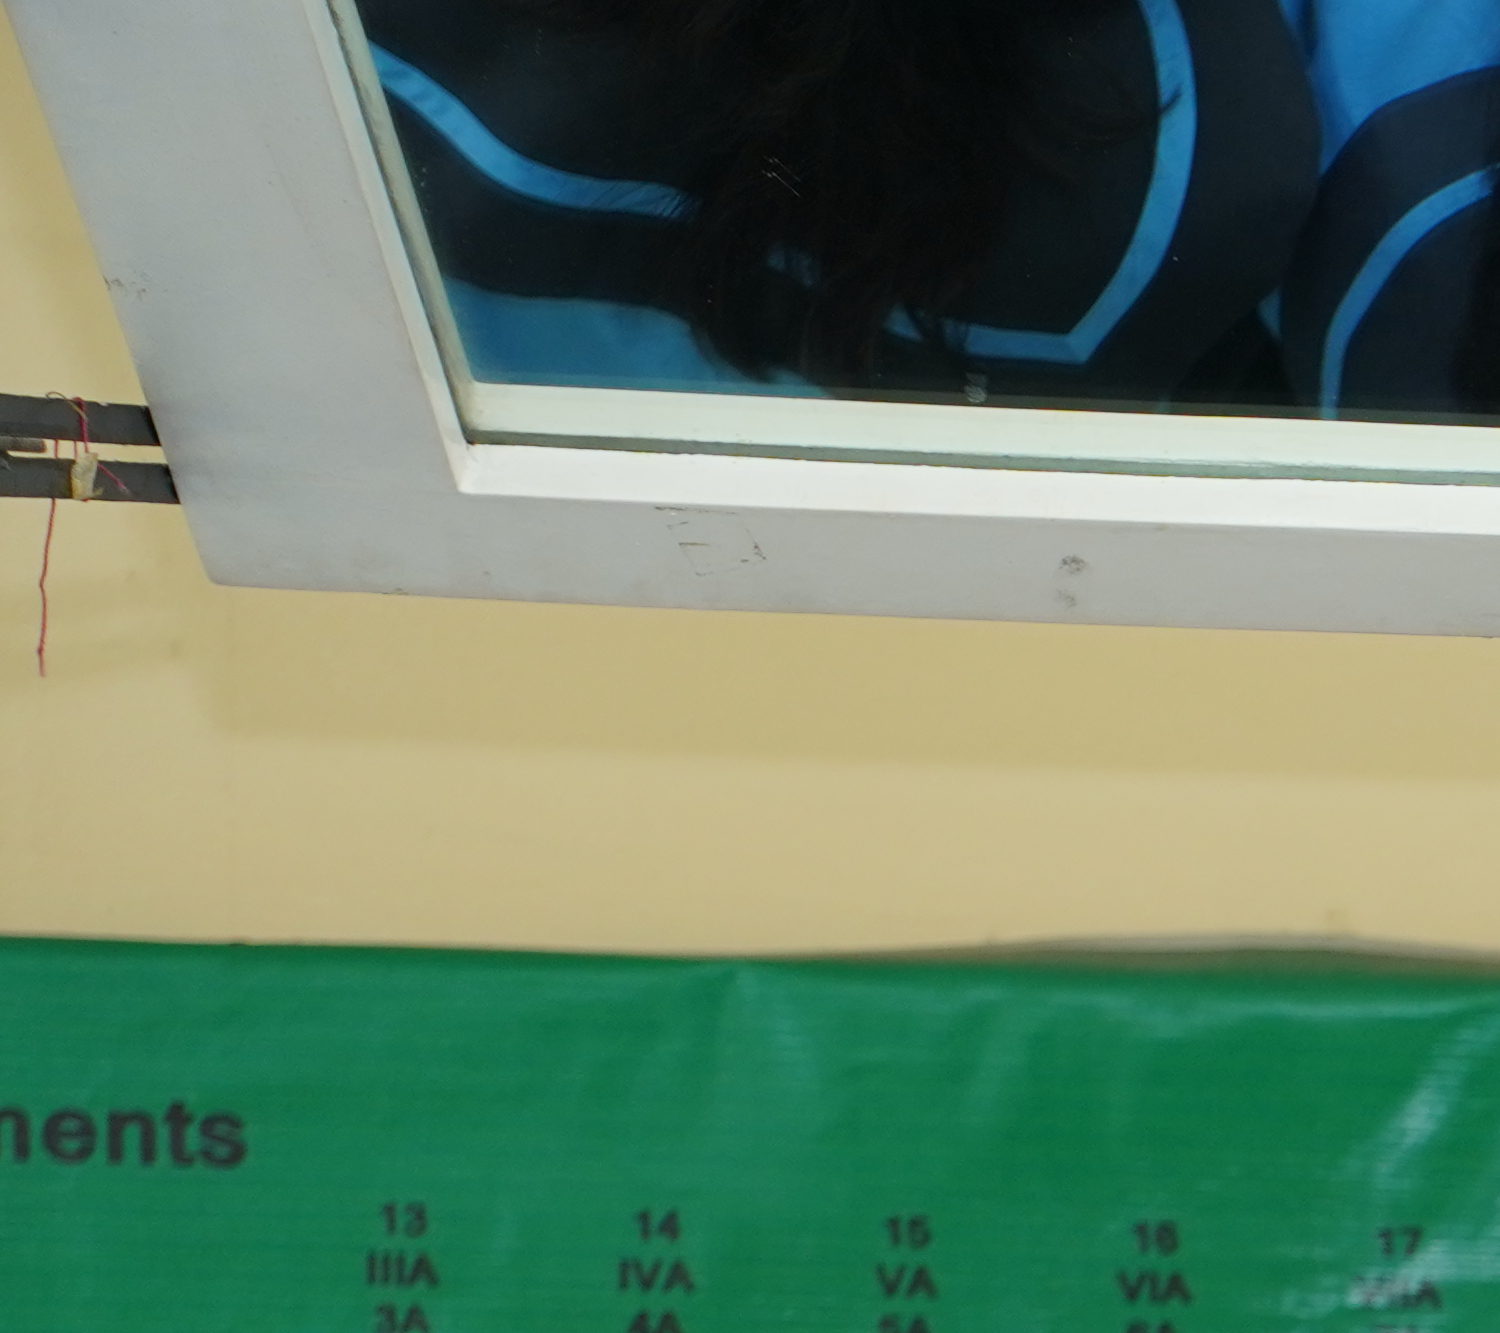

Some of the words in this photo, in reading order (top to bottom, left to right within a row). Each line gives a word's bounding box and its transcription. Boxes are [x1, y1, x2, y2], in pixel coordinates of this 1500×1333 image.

[382, 1203, 427, 1238] 13
[638, 1209, 680, 1242] 14
[885, 1215, 932, 1249] 15
[1377, 1227, 1424, 1257] 17
[366, 1252, 439, 1287] IIIA
[619, 1259, 694, 1293] IVA
[875, 1264, 938, 1299] VA
[1116, 1270, 1193, 1306] VIA
